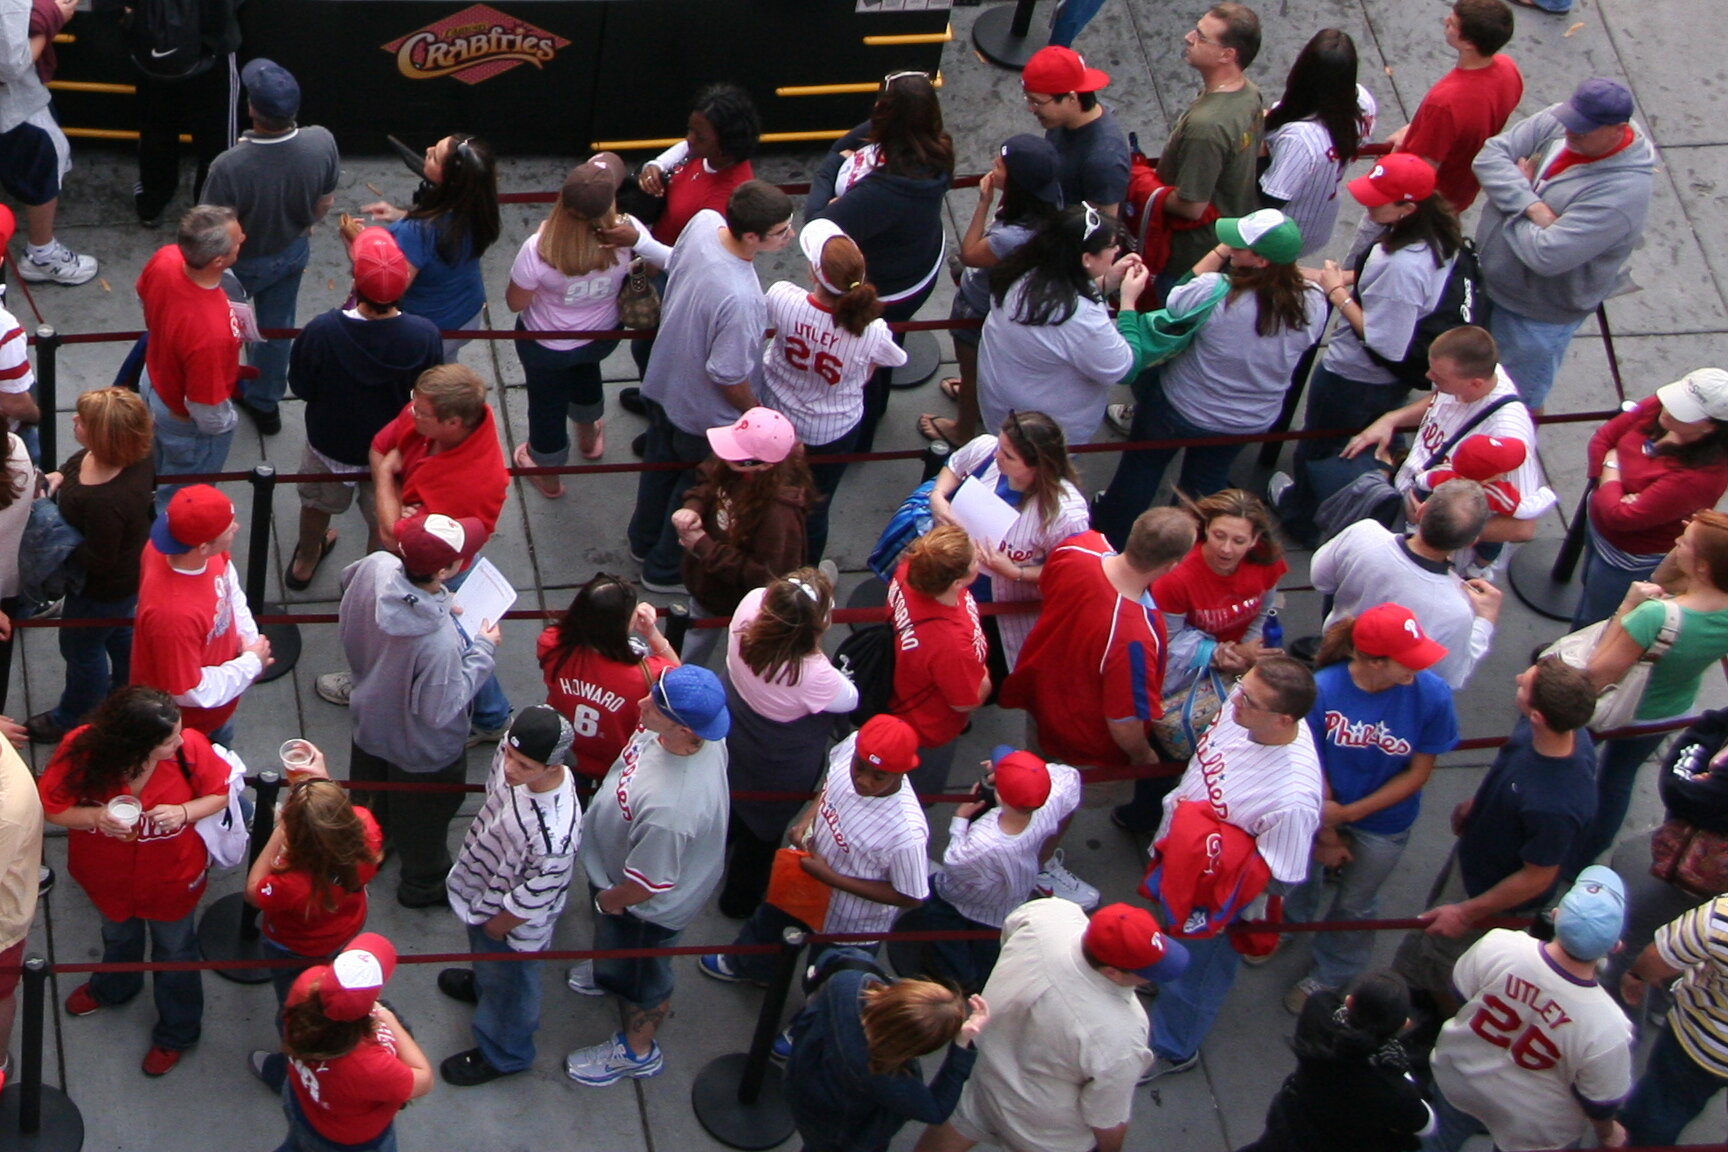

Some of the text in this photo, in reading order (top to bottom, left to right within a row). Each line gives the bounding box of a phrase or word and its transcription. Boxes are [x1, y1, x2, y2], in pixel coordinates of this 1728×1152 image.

[794, 321, 840, 350] UTLEY
[783, 335, 844, 386] 26
[559, 678, 626, 713] HOWARD
[573, 703, 600, 737] 6
[1325, 710, 1411, 756] Phillies
[1504, 973, 1572, 1030] UTLEY
[1468, 993, 1562, 1071] 26
